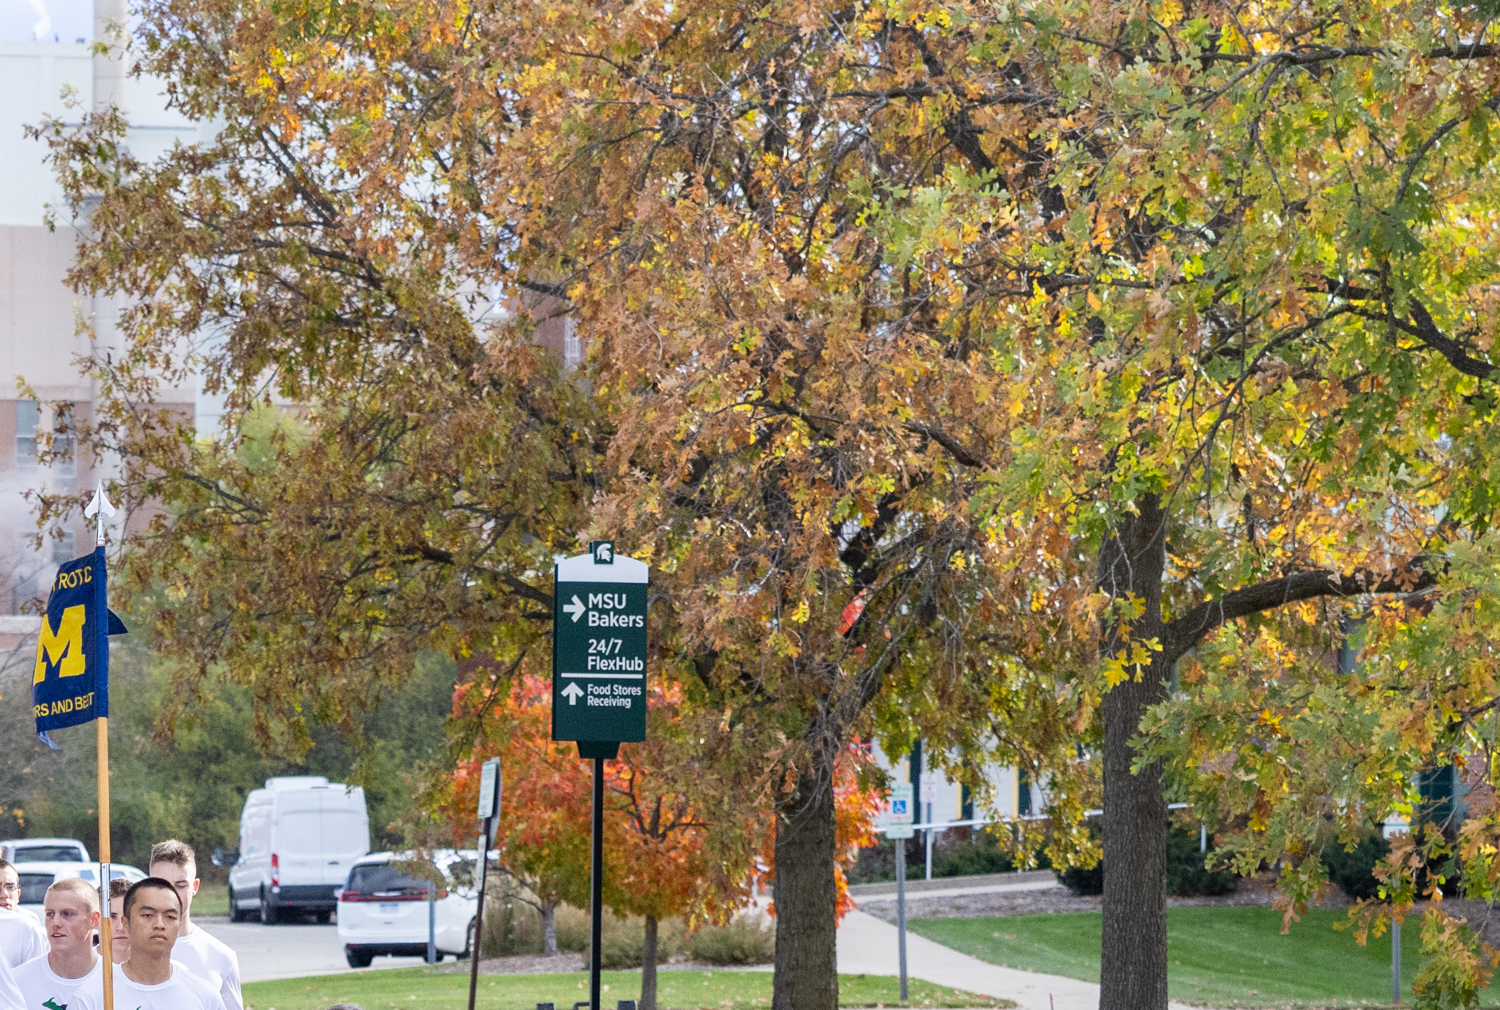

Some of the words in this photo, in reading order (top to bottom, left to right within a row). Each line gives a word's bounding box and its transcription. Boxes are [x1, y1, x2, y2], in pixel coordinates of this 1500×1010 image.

[58, 565, 93, 590] ROTC
[588, 593, 627, 609] MSU
[588, 611, 644, 628] Bakers
[33, 604, 86, 687] M
[587, 638, 623, 656] 24/7
[587, 656, 644, 671] FlexHub
[587, 683, 611, 696] Food
[612, 684, 642, 697] Stores
[51, 698, 74, 716] AND
[587, 695, 632, 709] Receiving
